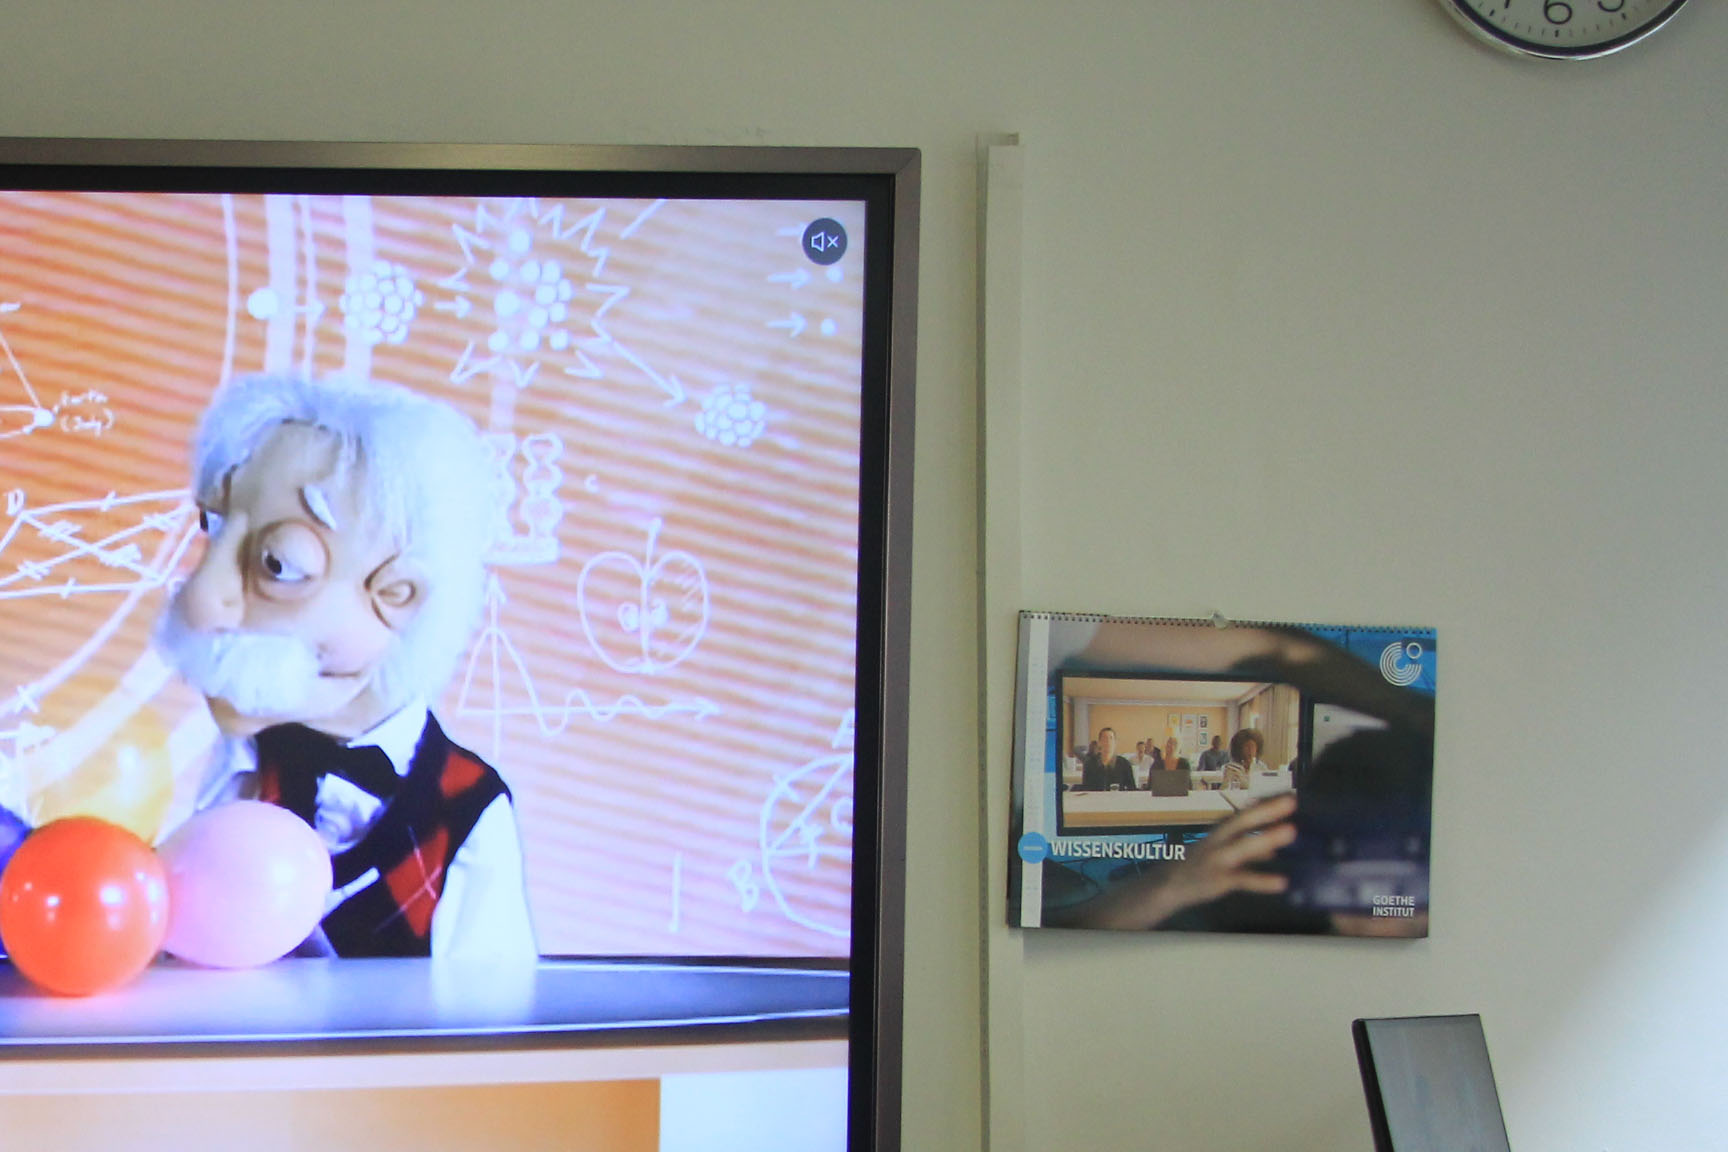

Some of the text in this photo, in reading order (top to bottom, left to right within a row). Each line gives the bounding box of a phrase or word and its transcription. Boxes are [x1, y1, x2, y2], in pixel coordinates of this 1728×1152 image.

[1544, 0, 1573, 25] 6
[1050, 840, 1187, 861] WISSENSKULTUR
[1372, 895, 1416, 907] GOETHE
[1372, 906, 1415, 917] INSTITUT
